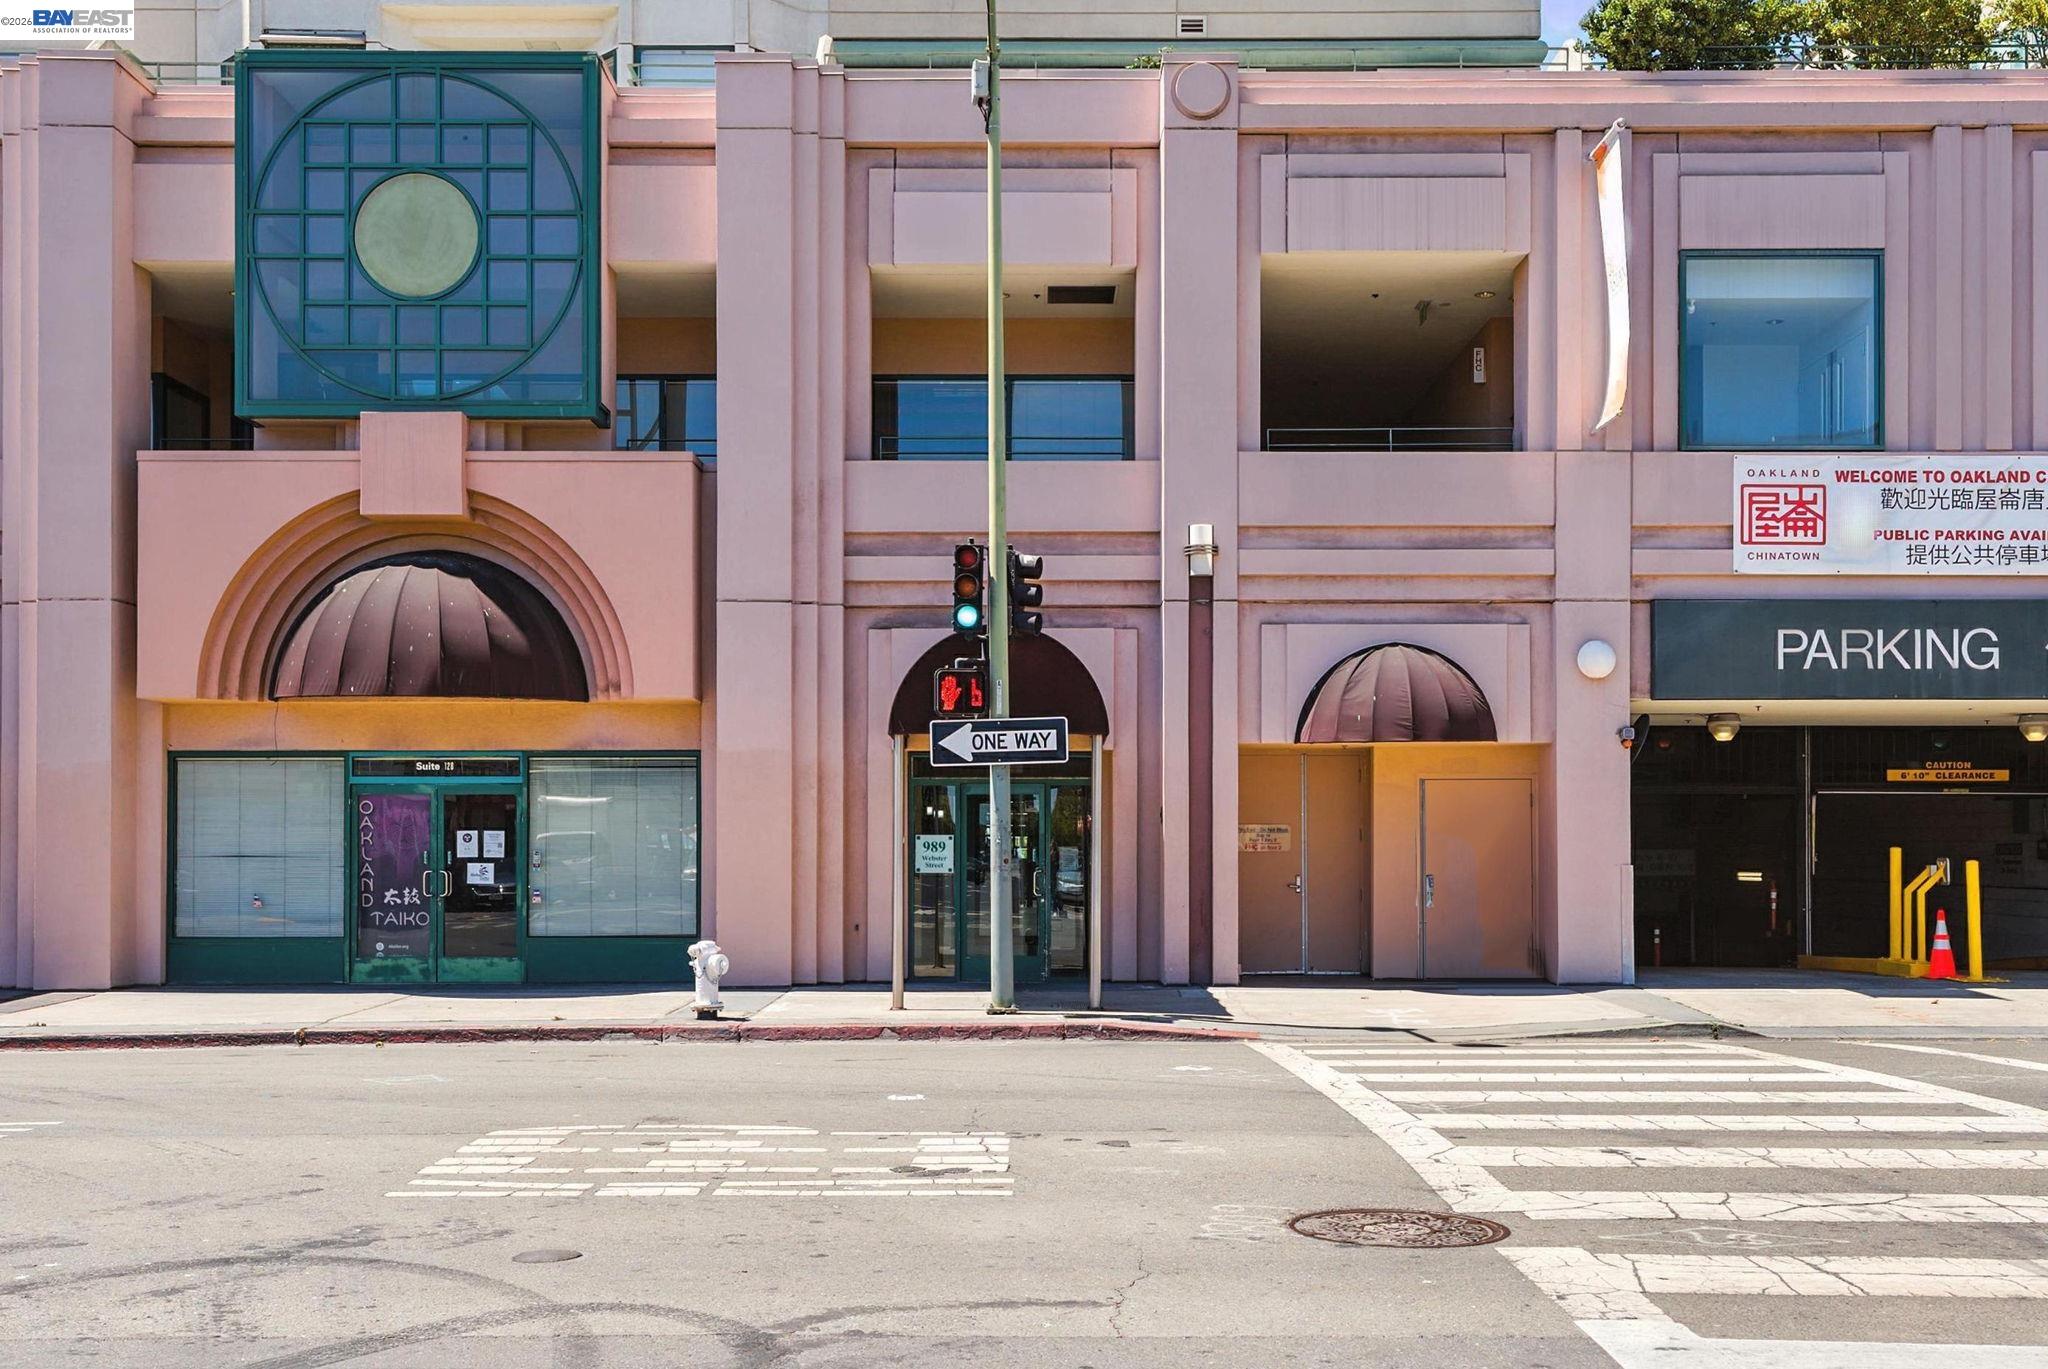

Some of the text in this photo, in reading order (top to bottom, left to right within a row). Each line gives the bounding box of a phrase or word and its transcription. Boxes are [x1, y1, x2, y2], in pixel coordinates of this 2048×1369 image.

[1747, 468, 1820, 478] OAKLAND
[1835, 470, 2048, 483] WELCOME TO OAKLAND C
[1881, 487, 2048, 511] 歡迎光臨屋崙唐
[1873, 529, 2048, 541] PUBLIC PARKING AVAI
[1747, 552, 1820, 560] CHINATOWN
[1777, 628, 2000, 670] PARKING
[972, 732, 1051, 750] ONE WAY
[415, 761, 441, 771] Suite
[1925, 761, 1972, 769] CAUTION
[922, 840, 946, 853] 989
[359, 800, 375, 908] OAKLAND
[370, 911, 430, 926] TAIKO
